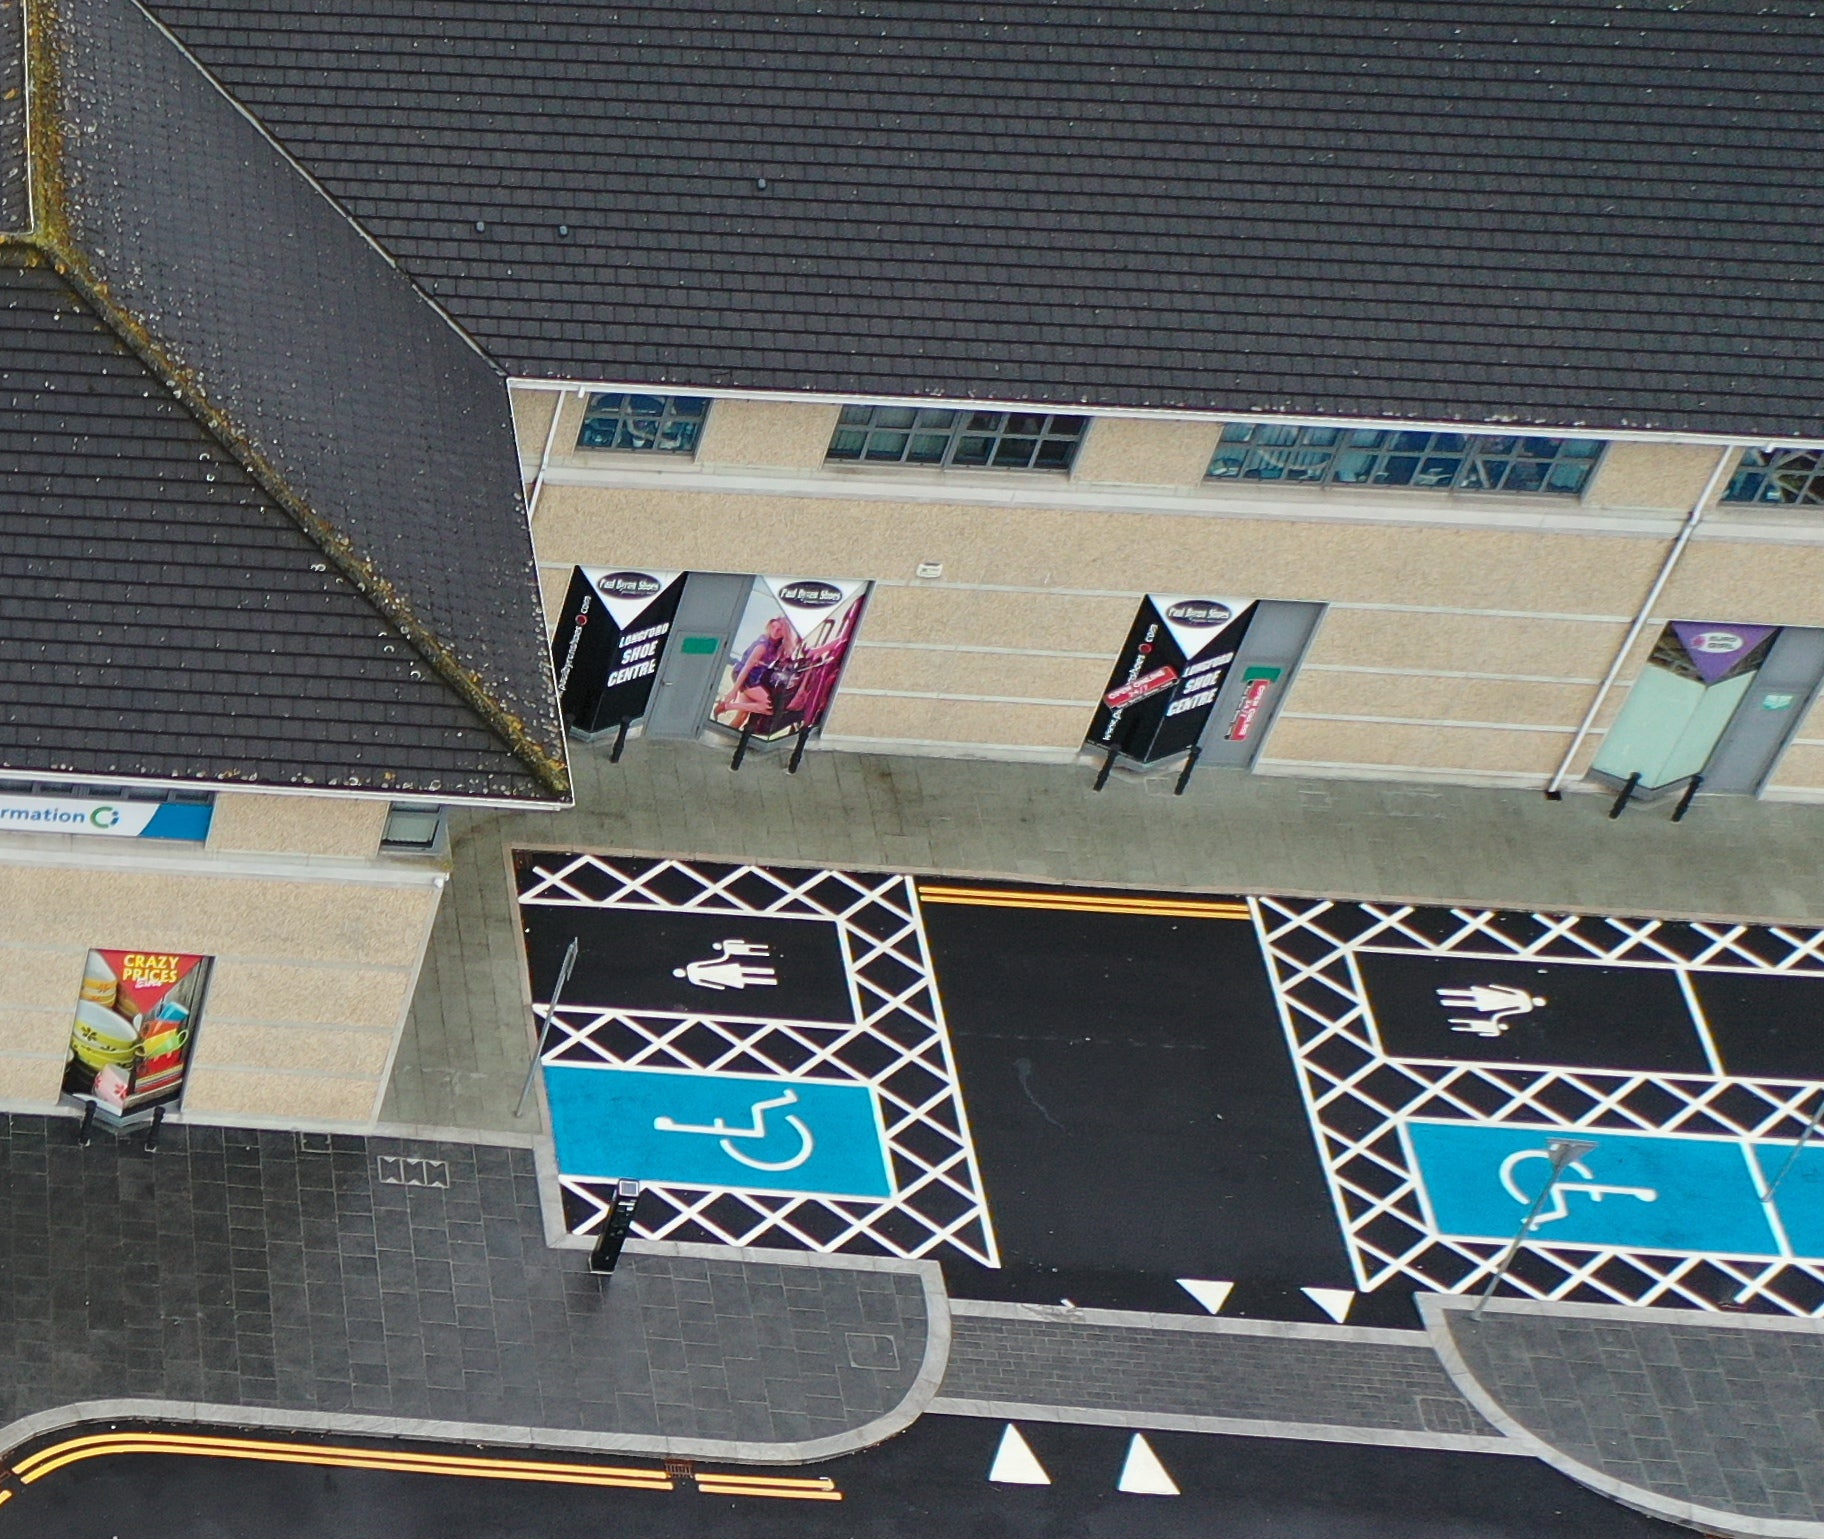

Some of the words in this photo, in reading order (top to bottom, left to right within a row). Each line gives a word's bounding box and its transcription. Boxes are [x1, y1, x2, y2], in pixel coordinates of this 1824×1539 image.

[621, 640, 659, 665] SHOE
[607, 659, 656, 688] CENTRE
[1184, 669, 1221, 694] SHOE
[1166, 688, 1218, 717] CENTRE
[124, 954, 179, 969] CRAZY
[122, 968, 177, 983] PRICES
